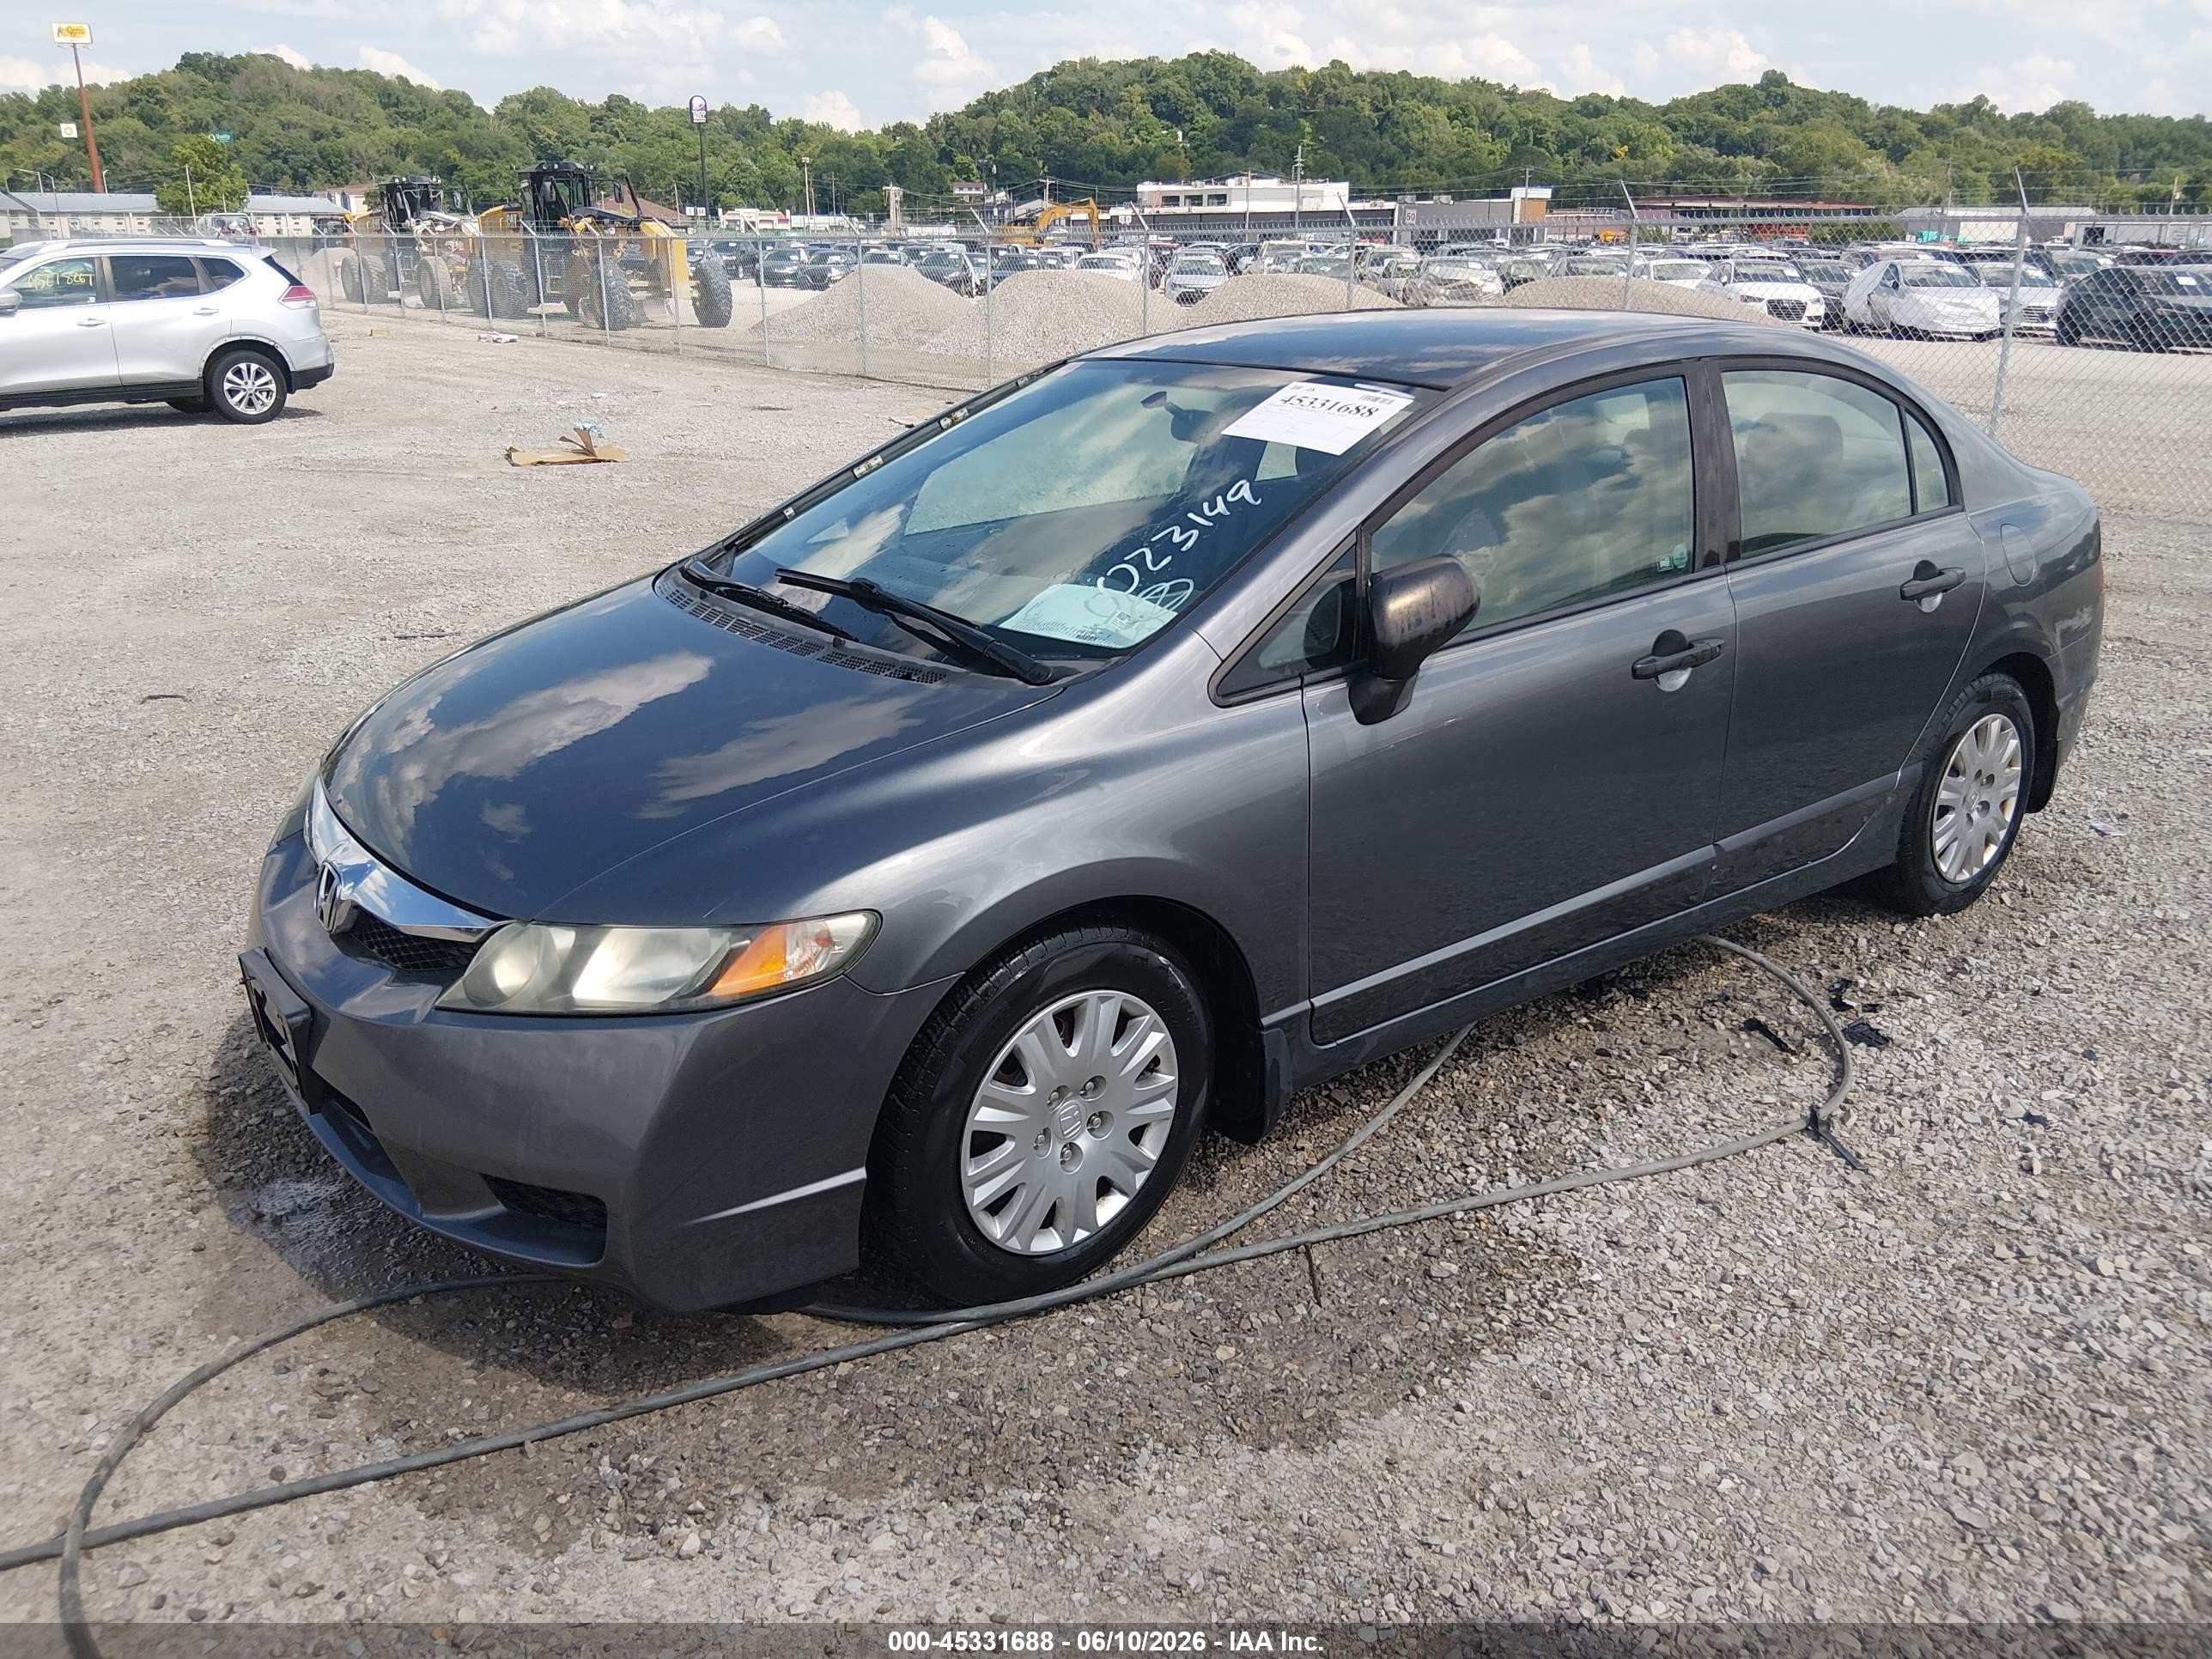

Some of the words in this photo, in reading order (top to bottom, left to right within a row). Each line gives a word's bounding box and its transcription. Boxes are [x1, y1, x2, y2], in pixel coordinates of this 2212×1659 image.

[1406, 212, 1416, 222] 50
[1280, 394, 1380, 418] 45331688
[1097, 478, 1262, 595] 023149
